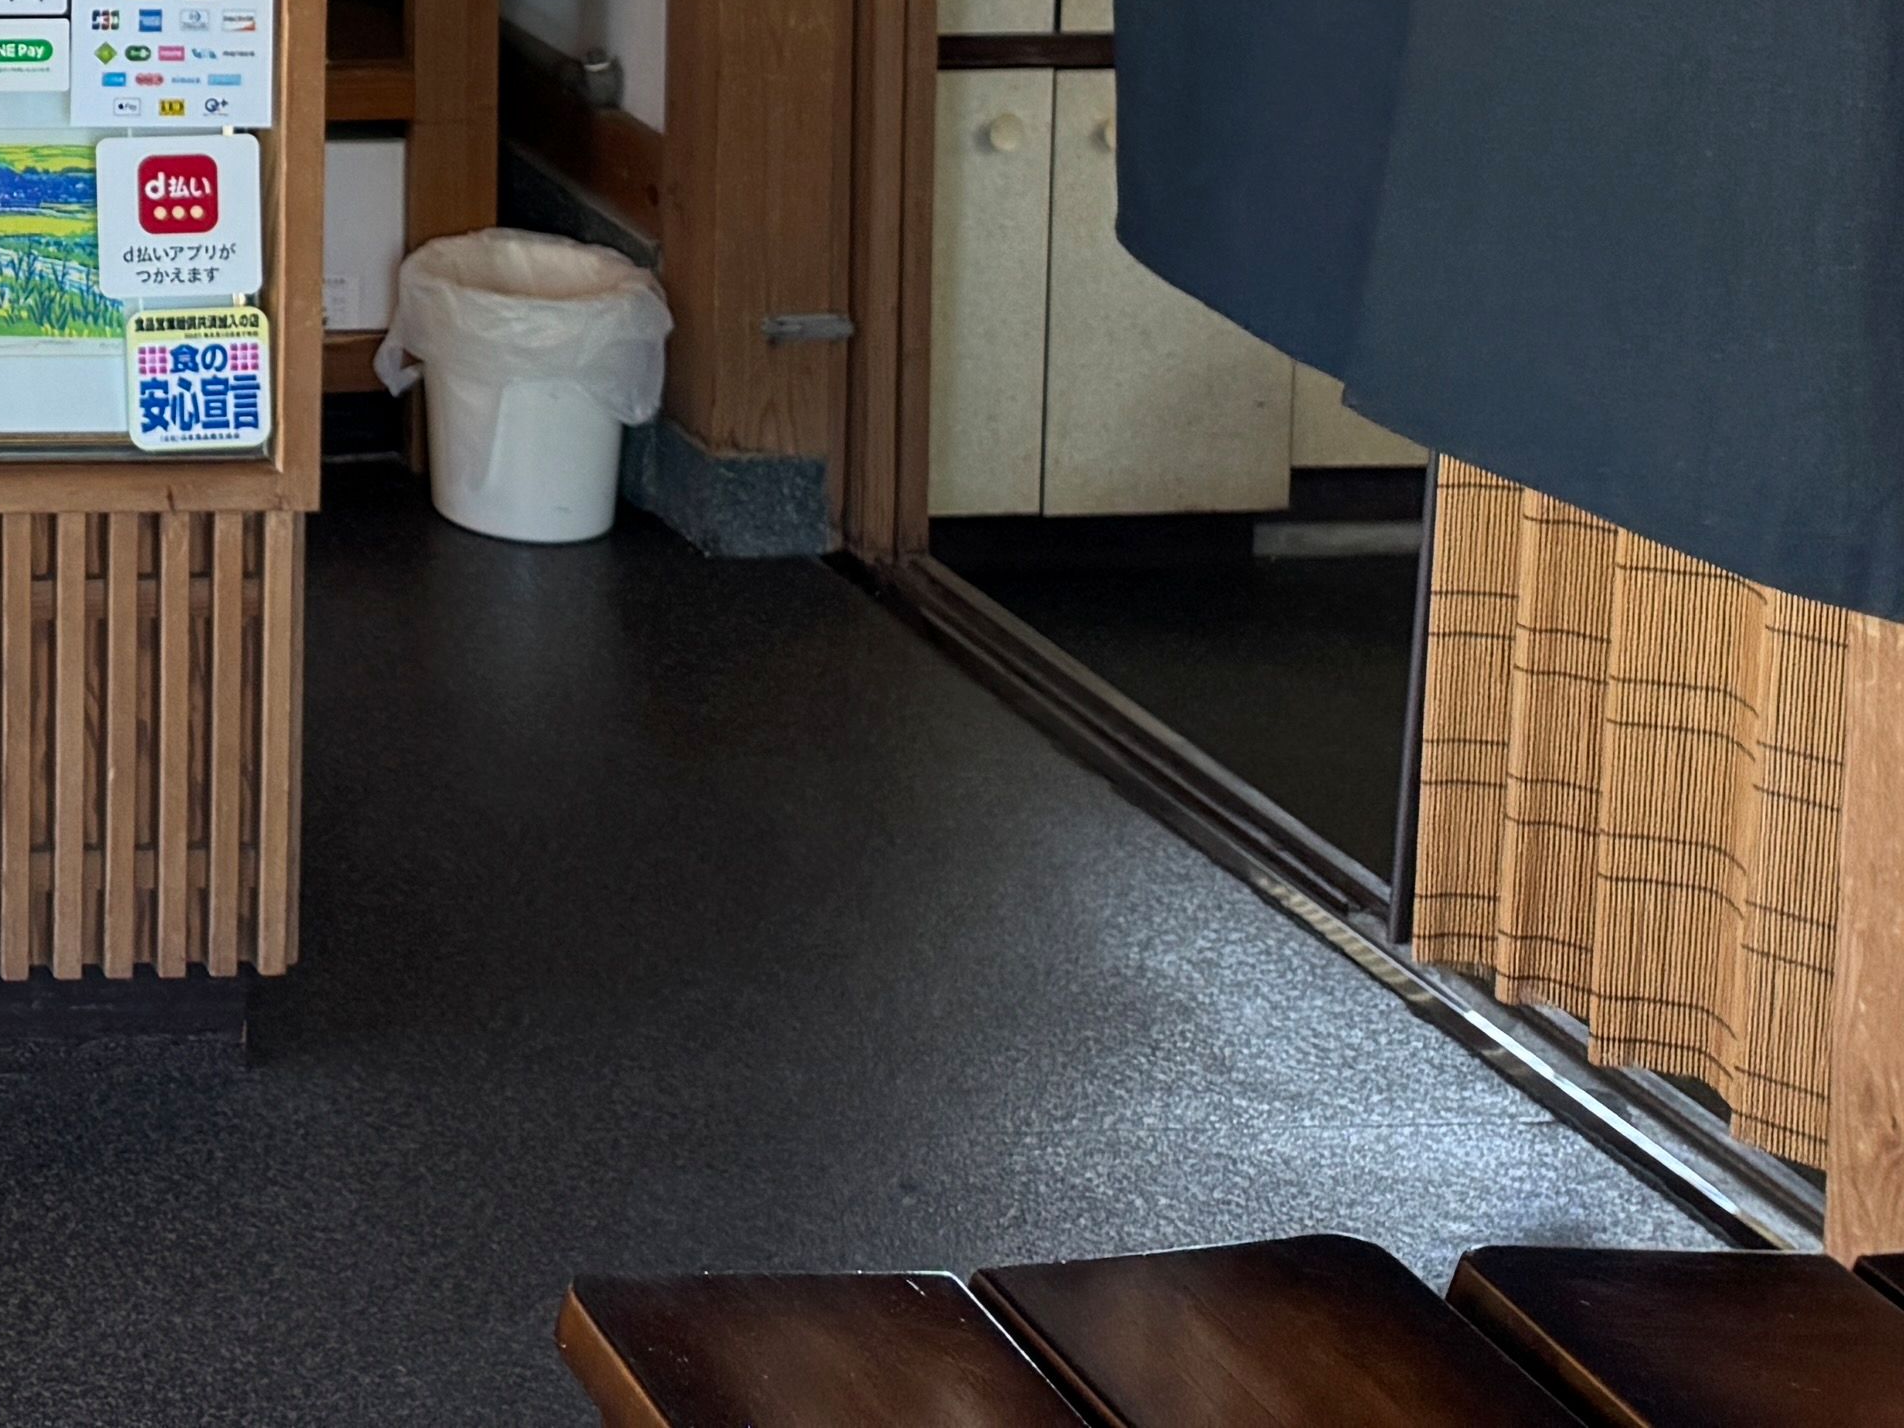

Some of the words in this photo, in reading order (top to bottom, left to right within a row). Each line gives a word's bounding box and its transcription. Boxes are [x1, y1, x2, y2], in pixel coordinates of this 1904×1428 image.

[18, 44, 45, 59] Pay
[145, 172, 213, 199] d払い
[122, 244, 237, 263] d払いアプリが
[135, 265, 220, 284] つかえます
[169, 343, 229, 373] 食の
[139, 374, 261, 433] 安心宣言
